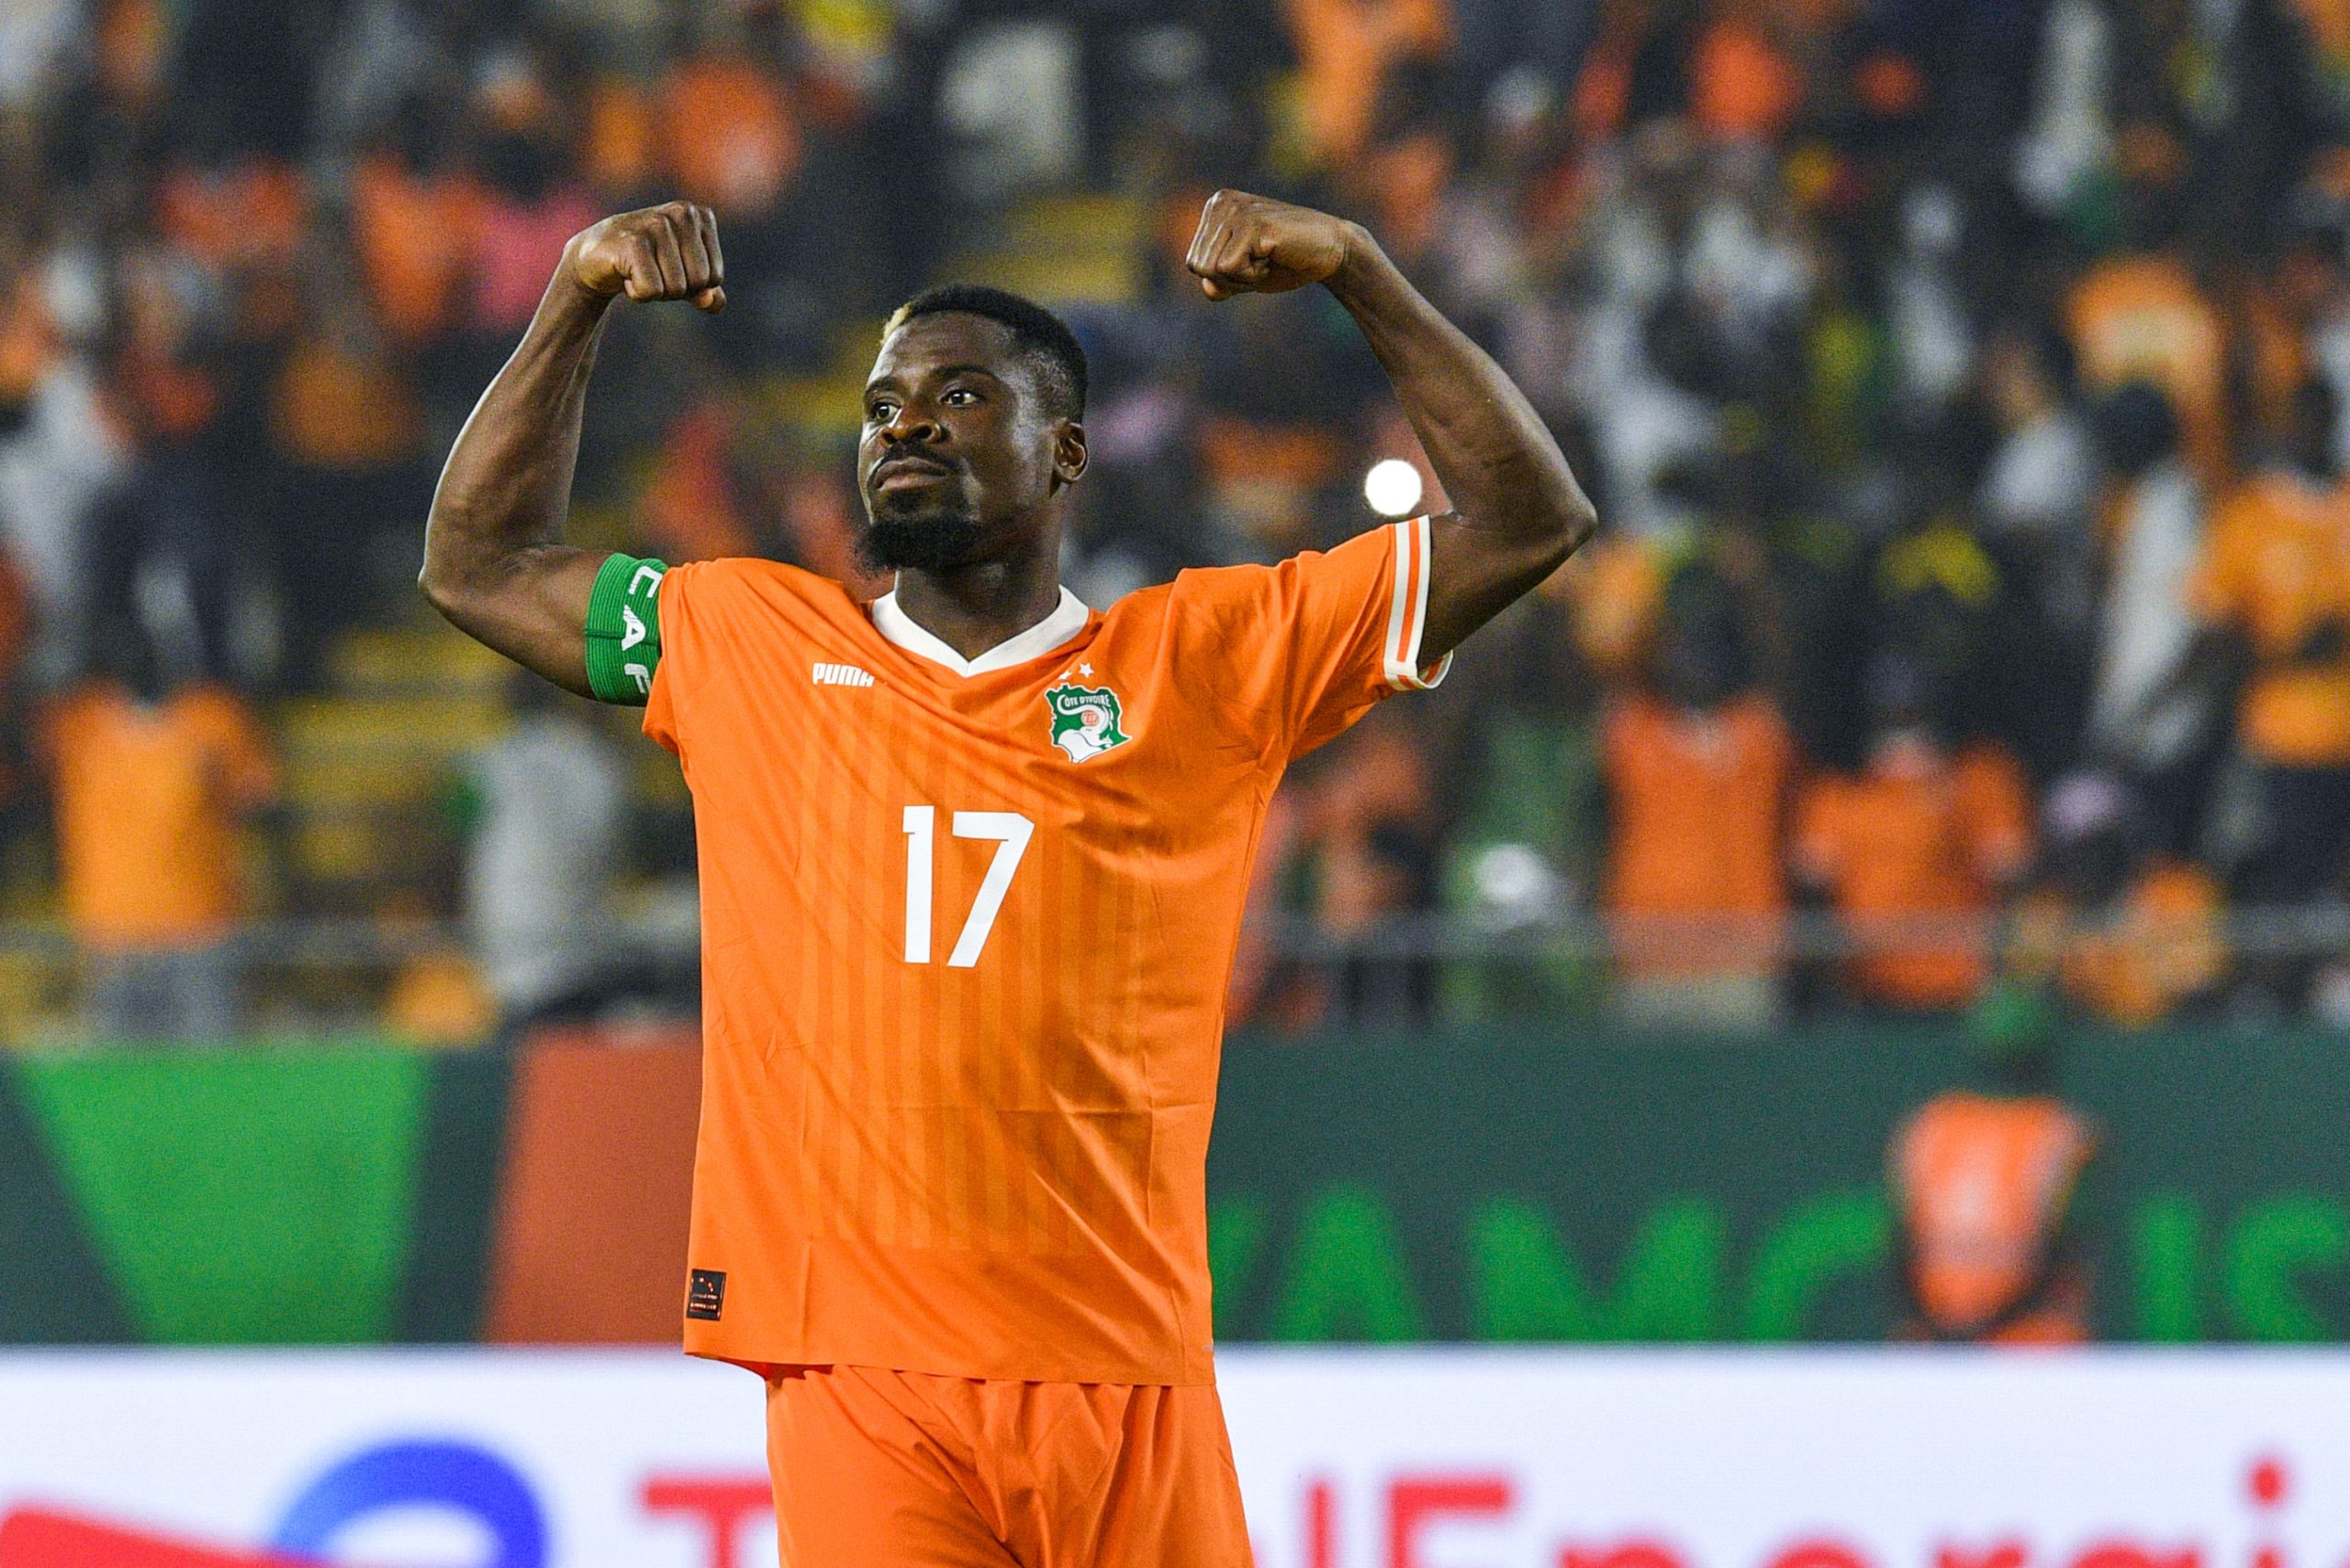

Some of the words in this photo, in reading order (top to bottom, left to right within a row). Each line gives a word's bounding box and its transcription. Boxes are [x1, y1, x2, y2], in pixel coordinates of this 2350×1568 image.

[621, 566, 663, 694] CAF
[812, 663, 876, 688] PUMA
[902, 805, 1035, 968] 17
